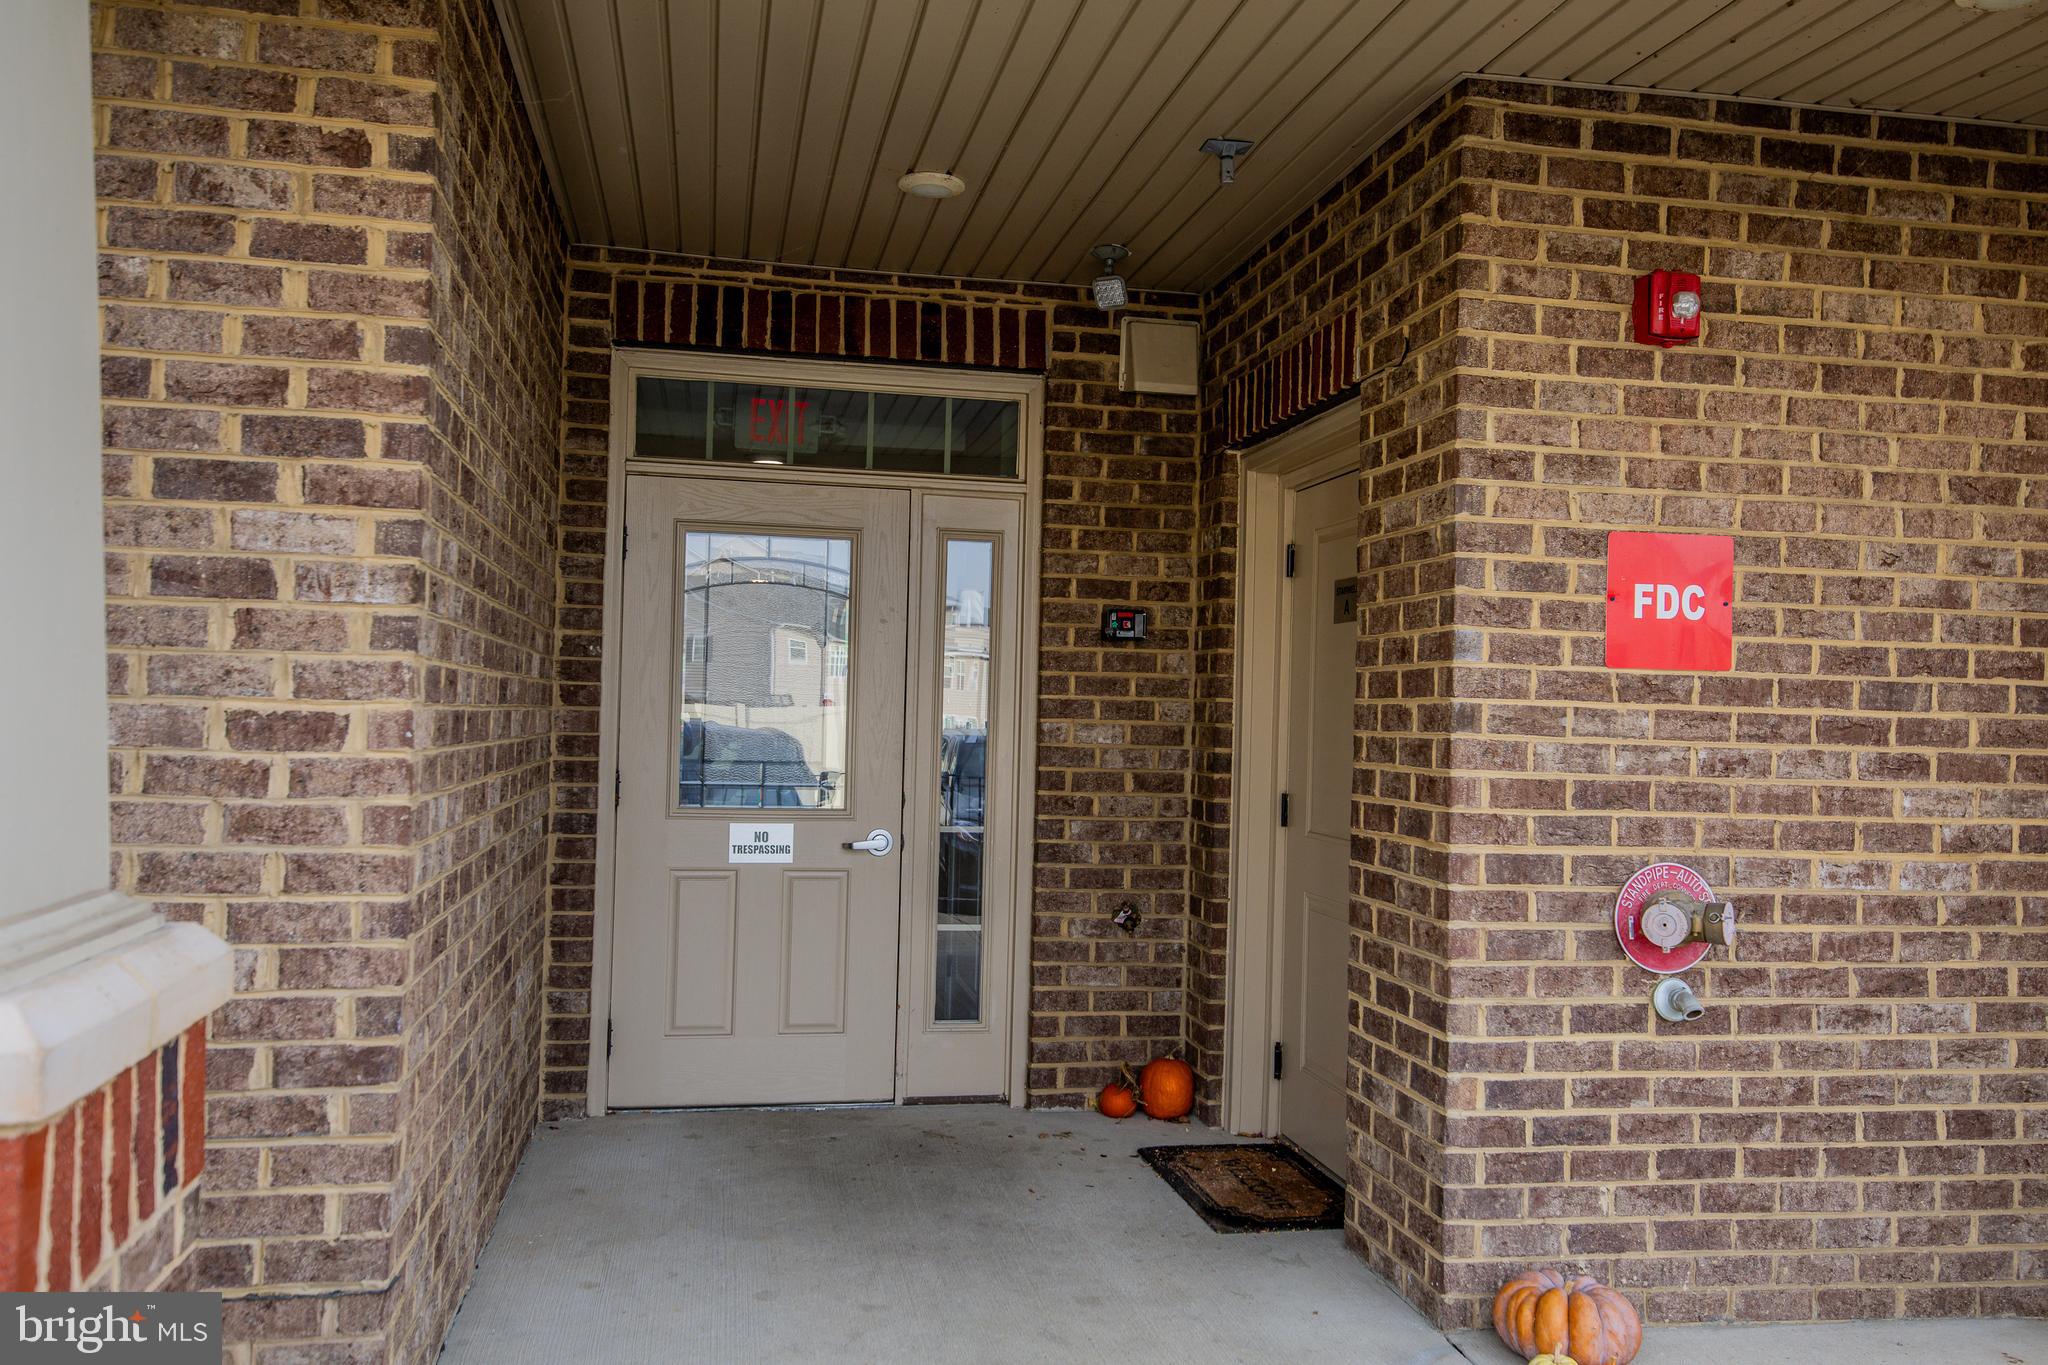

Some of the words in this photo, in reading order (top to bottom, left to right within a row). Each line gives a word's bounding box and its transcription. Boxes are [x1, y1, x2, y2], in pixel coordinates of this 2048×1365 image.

[751, 398, 810, 447] EXIT
[1633, 583, 1706, 621] FDC
[731, 844, 791, 855] TRESPASSING
[753, 831, 769, 843] NO
